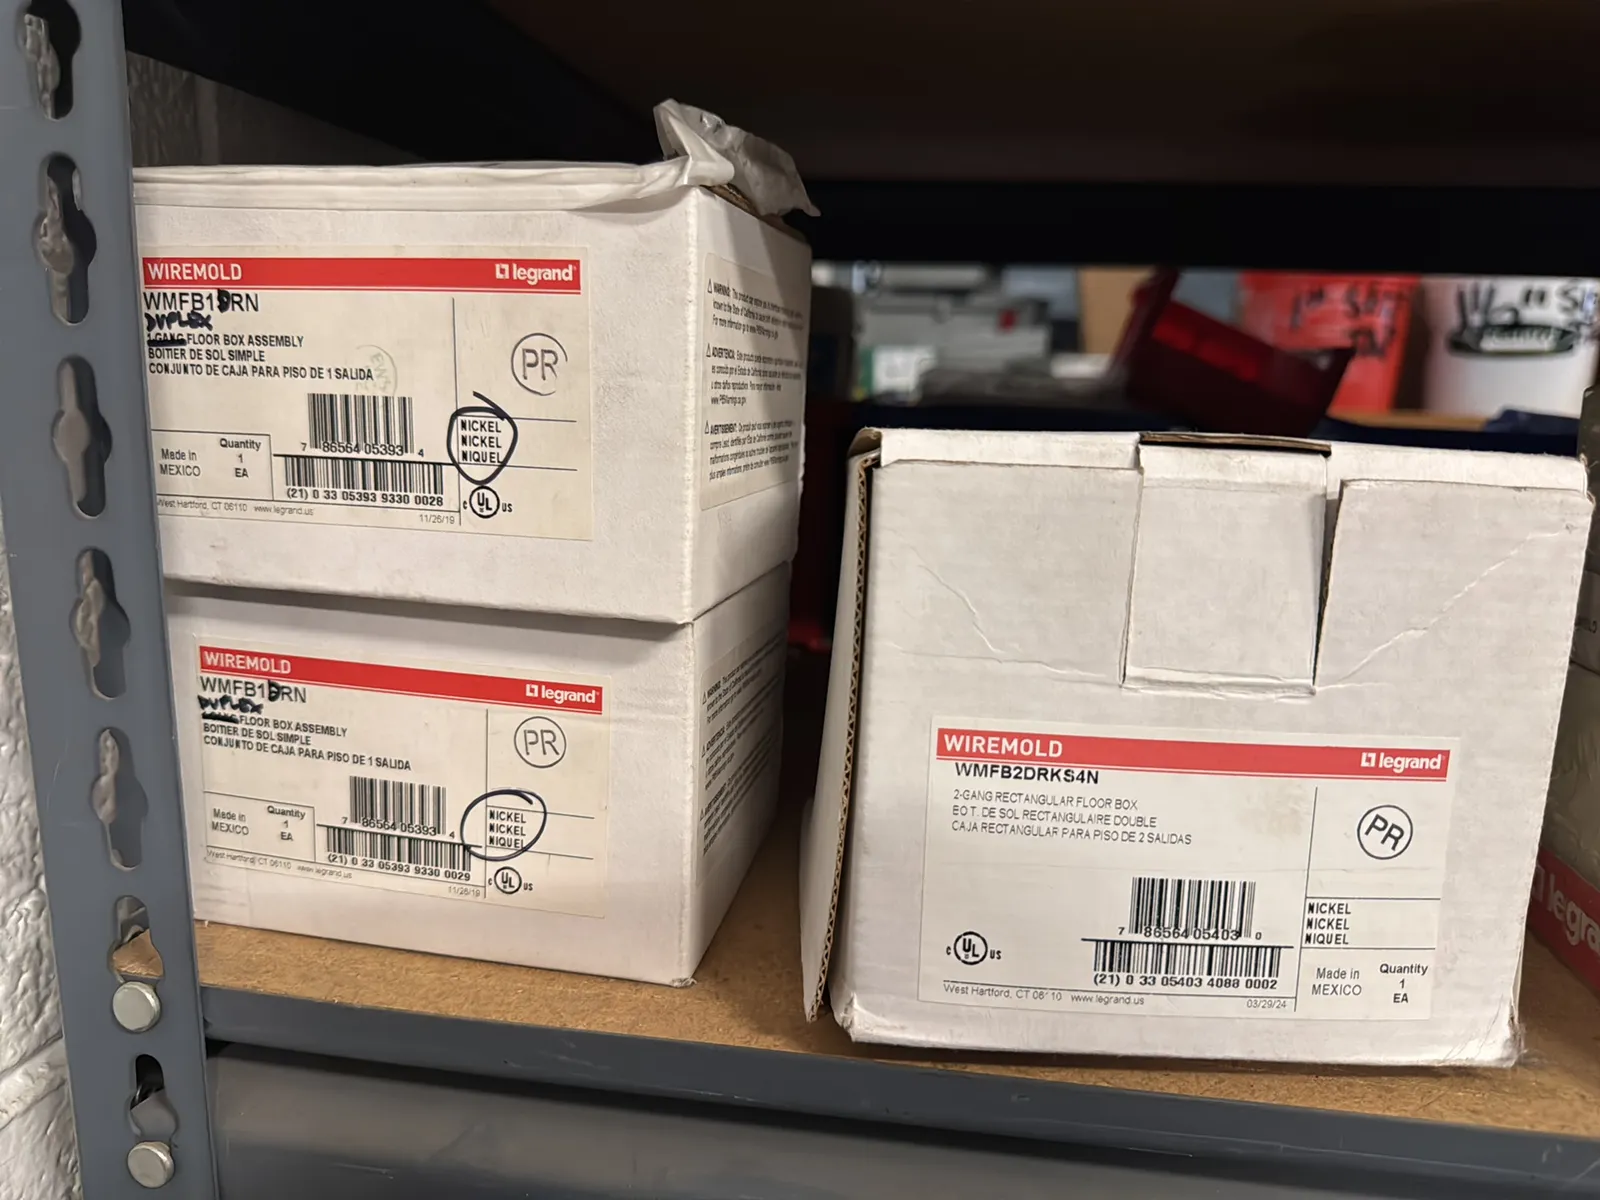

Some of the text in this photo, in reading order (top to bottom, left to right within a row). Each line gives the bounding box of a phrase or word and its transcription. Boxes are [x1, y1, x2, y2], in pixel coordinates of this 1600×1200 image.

[148, 263, 242, 280] WIREMOLD
[512, 264, 573, 285] legrand
[187, 333, 220, 346] FLOOR
[224, 334, 245, 346] BOX
[248, 335, 304, 348] ASSEMBLY
[149, 348, 265, 362] BOITIER DE SOL SIMPLE
[522, 348, 559, 380] PR
[149, 363, 374, 381] CONJUNTO DE CAJA PARA PISO DE 1 SALIDA
[460, 419, 502, 433] NICKEL
[219, 438, 261, 451] Quantity
[460, 435, 502, 448] NICKEL
[161, 449, 197, 461] Made in
[301, 442, 424, 457] 7 86564 05393 4
[461, 450, 503, 464] NIQUEL
[238, 453, 243, 463] 1
[159, 464, 201, 477] MEXICO
[235, 467, 249, 478] EA
[287, 488, 308, 500] (21)
[312, 489, 319, 499] 0
[323, 490, 337, 500] 33
[341, 491, 377, 503] 05393
[381, 494, 410, 505] 9330
[211, 502, 222, 511] CT
[224, 502, 247, 512] 06110
[204, 651, 291, 674] WIREMOLD
[541, 685, 596, 704] legrand
[203, 722, 311, 746] BOITIER DE SOL SIMPLE
[240, 715, 270, 728] FLOOR
[272, 719, 293, 731] BOX
[295, 722, 348, 738] ASSEMBLY
[523, 729, 560, 756] PR
[944, 734, 1063, 758] WIREMOLD
[203, 735, 411, 771] CONJUNTO DE CAJA PARA PISO DE 1 SALIDA
[1378, 752, 1442, 774] legrand
[955, 762, 1099, 785] WMFB2DRKS4N
[953, 788, 1138, 811] 2-GANG RECTANGULAR FLOOR BOX
[213, 808, 246, 822] Made in
[267, 805, 306, 820] Quantity
[489, 809, 526, 824] NICKEL
[982, 806, 996, 818] DE
[999, 808, 1020, 820] SOL
[1022, 810, 1111, 826] RECTANGULAIRE
[1113, 815, 1157, 828] DOUBLE
[211, 821, 249, 836] MEXICO
[283, 820, 289, 828] 1
[341, 816, 455, 839] 7 86564 05393 4
[489, 823, 526, 836] NICKEL
[280, 831, 294, 841] EA
[951, 820, 978, 832] CAJA
[1061, 827, 1091, 840] PARA
[1093, 829, 1119, 842] PISO
[1121, 831, 1136, 843] DE
[1138, 832, 1145, 843] 2
[1147, 832, 1192, 845] SALIDAS
[1364, 813, 1405, 851] PR
[489, 835, 525, 849] NIQUEL
[258, 856, 268, 865] CT
[327, 852, 471, 882] (21) 0 33 05393 9330 0029
[1307, 902, 1351, 915] NICKEL
[1306, 918, 1350, 930] NICKEL
[1118, 927, 1262, 941] 7 86564 05403 0
[1304, 933, 1349, 945] NIQUEL
[1316, 967, 1360, 980] Made in
[1379, 963, 1428, 976] Quantity
[1094, 974, 1120, 987] (21)
[1126, 975, 1134, 986] 0
[1139, 975, 1156, 986] 33
[1161, 976, 1203, 988] 05403
[1245, 979, 1278, 990] 0002
[1399, 978, 1405, 989] 1
[943, 984, 969, 995] West
[1016, 990, 1030, 999] CT
[1311, 984, 1362, 996] MEXICO
[1246, 999, 1287, 1009] 03/29/24
[1393, 993, 1409, 1004] EA
